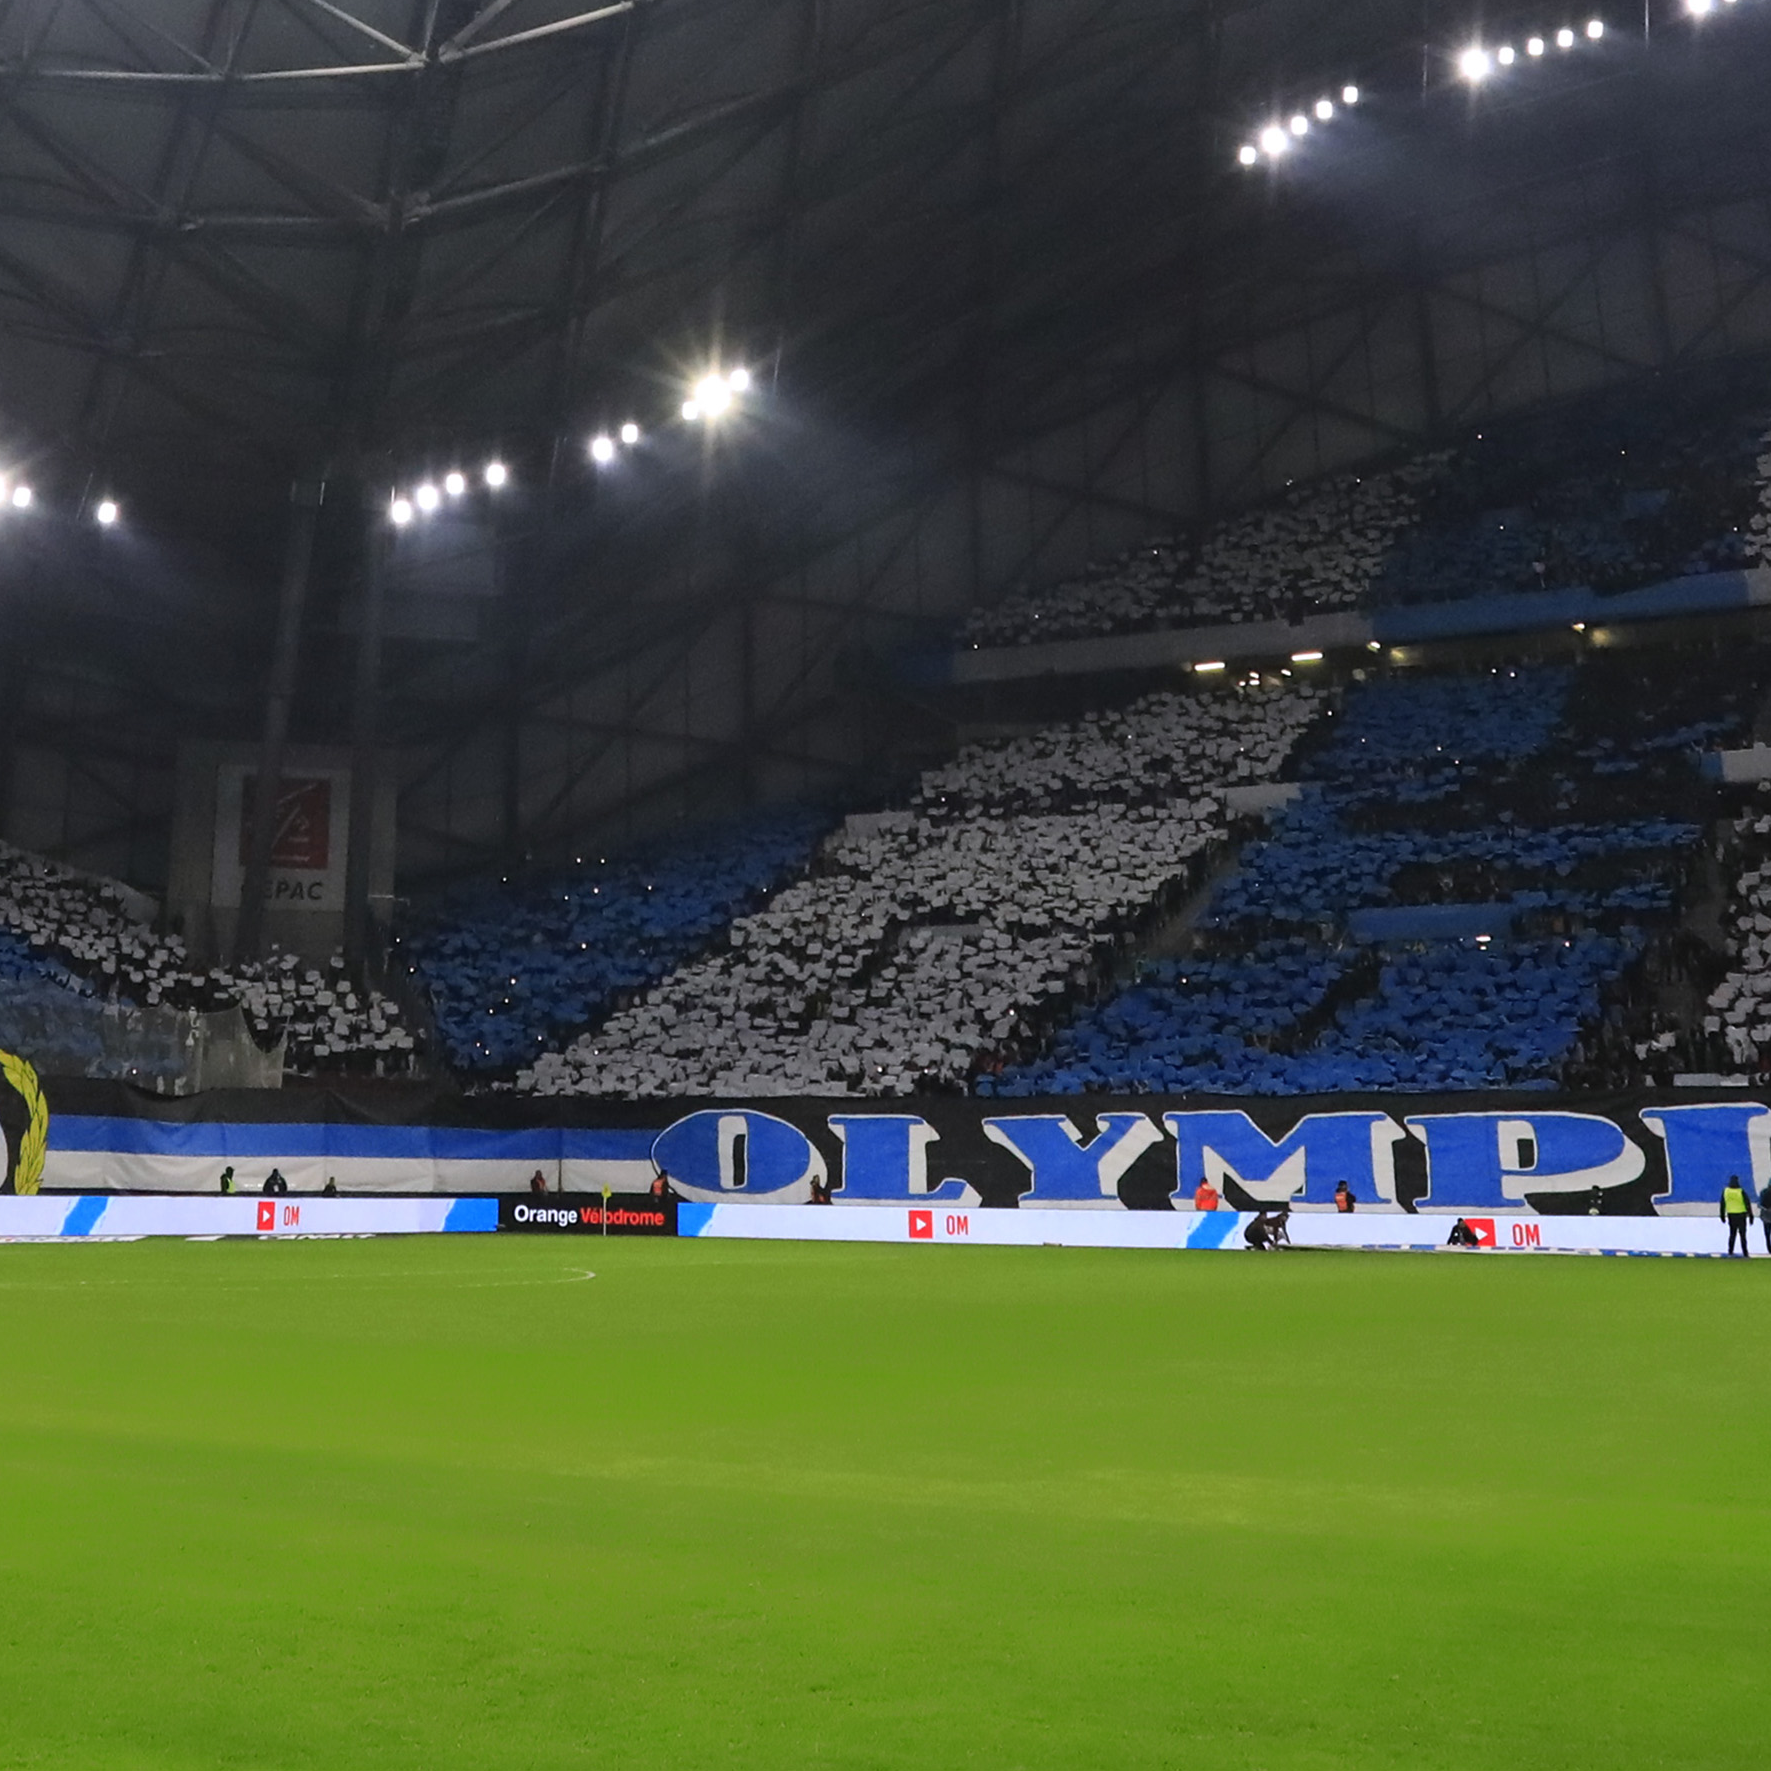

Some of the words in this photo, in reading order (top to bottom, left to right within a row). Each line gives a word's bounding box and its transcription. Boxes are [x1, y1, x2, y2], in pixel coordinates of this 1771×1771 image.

[264, 879, 324, 901] EPAC
[283, 1204, 300, 1227] OM
[514, 1204, 578, 1227] Orange
[580, 1206, 665, 1226] Vélodrome
[945, 1214, 969, 1236] OM
[1512, 1223, 1541, 1247] OM
